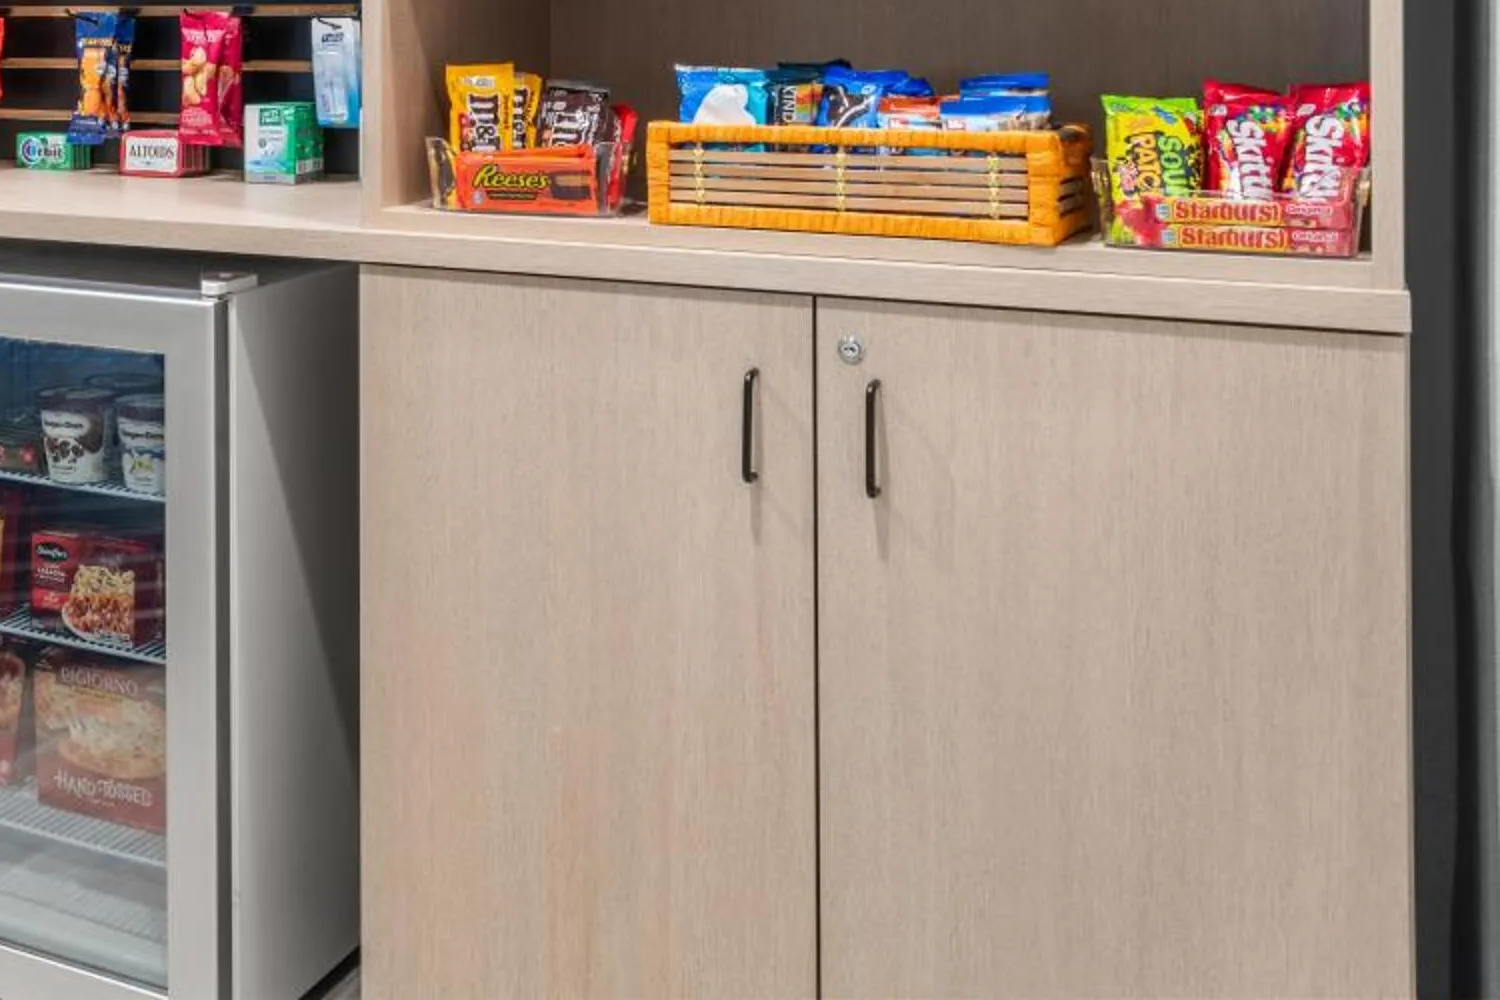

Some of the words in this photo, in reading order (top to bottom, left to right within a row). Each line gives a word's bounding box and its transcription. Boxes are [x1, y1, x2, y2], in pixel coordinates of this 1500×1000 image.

[781, 85, 797, 124] KIND
[128, 143, 175, 160] ALTOIDS
[1174, 201, 1281, 223] Starburst
[1181, 227, 1288, 250] Starburst
